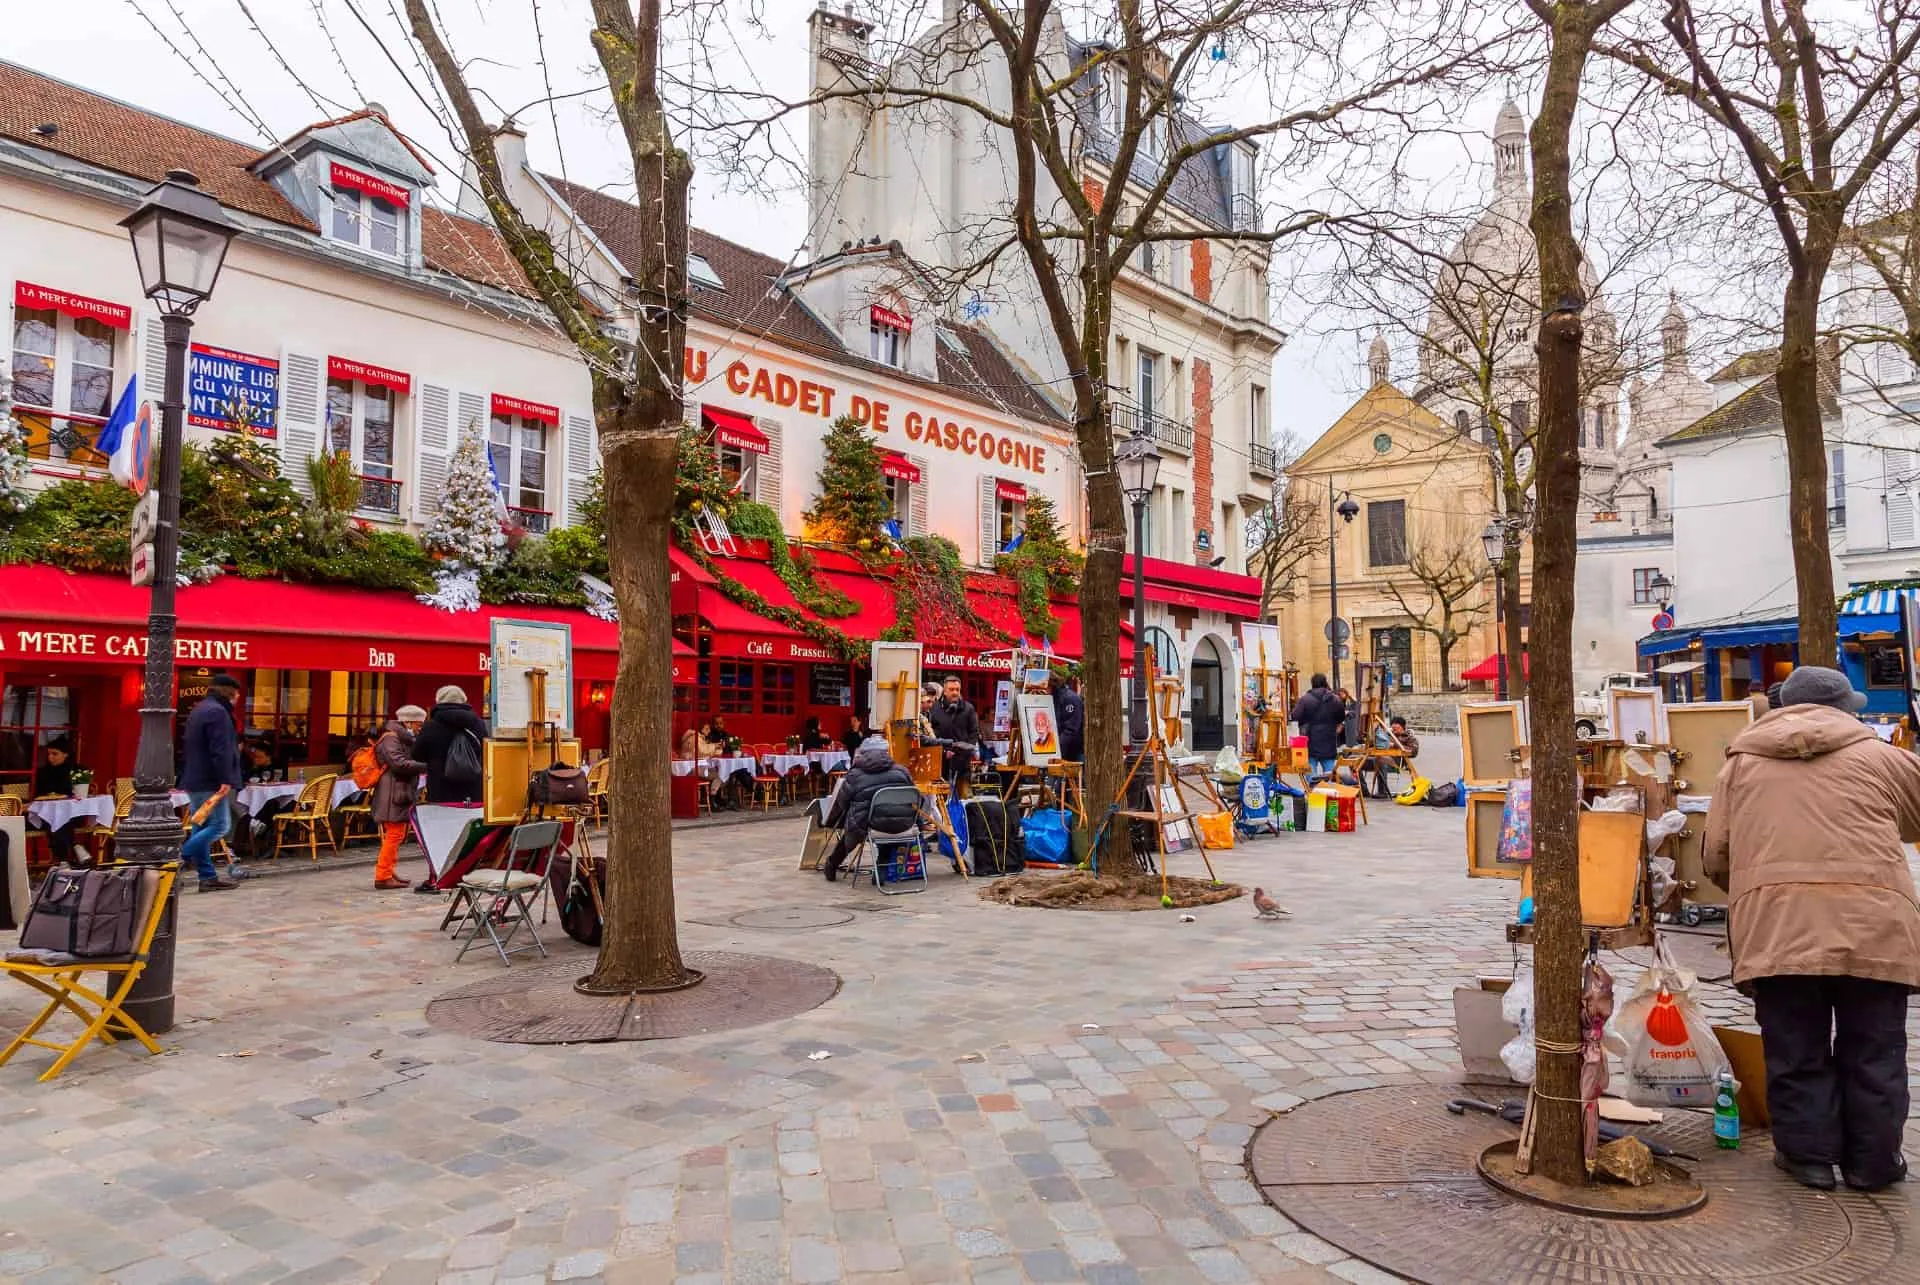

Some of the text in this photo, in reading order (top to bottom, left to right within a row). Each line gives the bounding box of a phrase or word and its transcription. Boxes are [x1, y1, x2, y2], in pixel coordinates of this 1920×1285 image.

[334, 168, 344, 177] LA
[21, 286, 127, 319] LA MERE CATHERINE
[251, 369, 279, 389] LIB
[332, 360, 408, 384] LA MERE CATHERINE
[194, 375, 271, 404] du vieux
[684, 347, 1046, 474] U CADET DE GASCOGNE
[721, 431, 766, 453] Restaurant
[18, 631, 97, 655] MERE
[104, 635, 248, 661] CATERINE
[747, 641, 832, 659] Café Brasseri
[925, 652, 937, 664] AU
[938, 651, 965, 666] CADET
[967, 656, 977, 666] de
